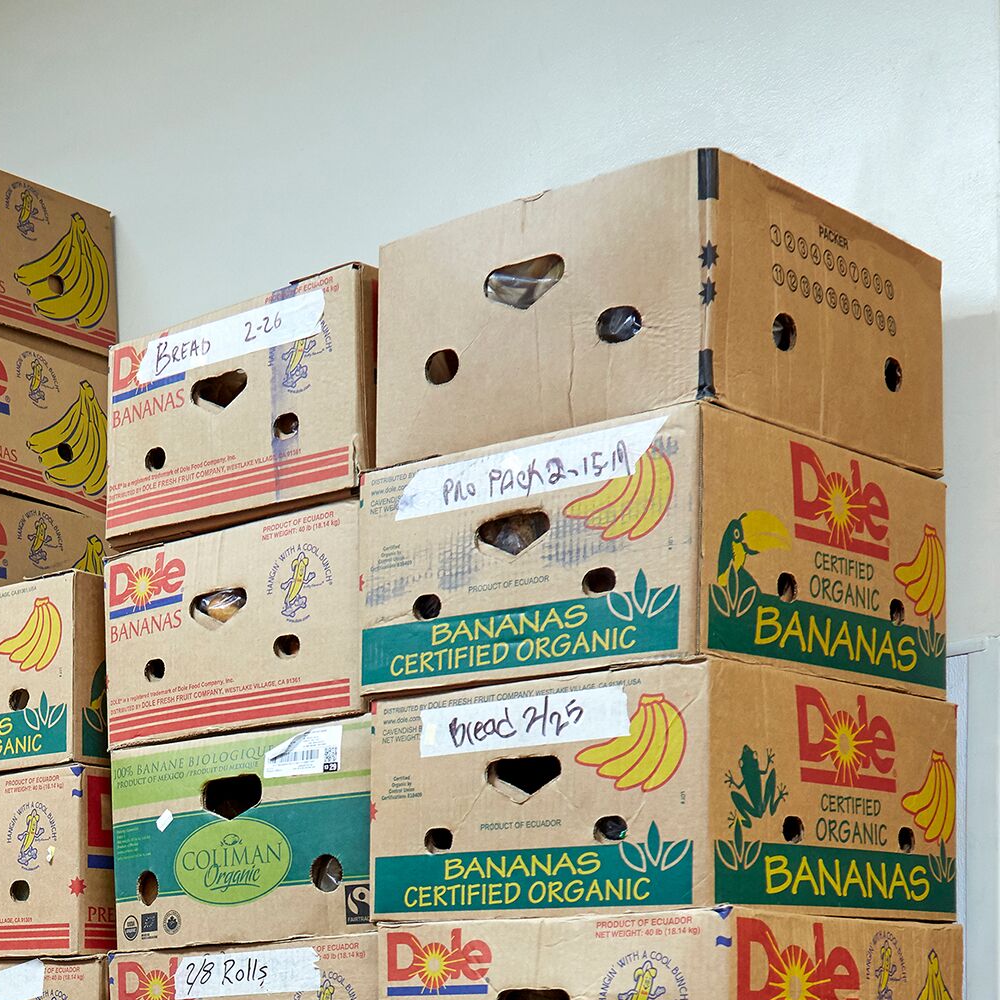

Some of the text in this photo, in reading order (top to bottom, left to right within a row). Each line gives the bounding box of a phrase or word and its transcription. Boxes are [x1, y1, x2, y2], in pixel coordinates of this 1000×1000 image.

[819, 224, 848, 250] PACKER
[155, 312, 281, 376] BREAD 2-26
[113, 388, 185, 429] BANANAS
[790, 441, 889, 543] Dole
[263, 511, 334, 533] PRODUCT OF ECUADOR
[109, 552, 186, 608] Dole
[814, 551, 874, 582] CERTIFIED
[468, 584, 501, 593] PRODUCT
[515, 576, 549, 587] ECUADOR
[810, 575, 880, 611] ORGANIC
[110, 610, 182, 643] BANANAS
[432, 605, 588, 645] BANANAS
[755, 605, 917, 671] BANANAS
[391, 626, 637, 677] CERTIFIED ORGANIC
[383, 705, 418, 715] DISTRIBUTED
[428, 699, 447, 709] DOLE
[474, 695, 495, 704] FRUIT
[450, 696, 583, 747] Bread 2/25
[795, 684, 897, 779] Dole
[114, 758, 184, 779] 100% BANANE
[117, 772, 184, 789] PRODUCT OF MEXICO
[820, 794, 882, 816] CERTIFIED
[480, 819, 561, 831] PRODUCT OF ECUADOR
[815, 817, 887, 847] ORGANIC
[182, 841, 281, 871] COLIMAN
[445, 852, 601, 880] BANANAS
[204, 864, 260, 893] Organic
[404, 878, 650, 908] CERTIFIED ORGANIC
[764, 855, 930, 901] BANANAS
[597, 920, 635, 928] PRODUCT
[651, 916, 692, 926] ECUADOR
[612, 928, 643, 938] WEIGHT:
[645, 928, 653, 936] 40
[655, 928, 662, 936] lb
[689, 926, 700, 936] kg)
[224, 959, 267, 986] Rolls
[387, 928, 492, 988] Dole
[617, 950, 671, 970] WITH A COOL
